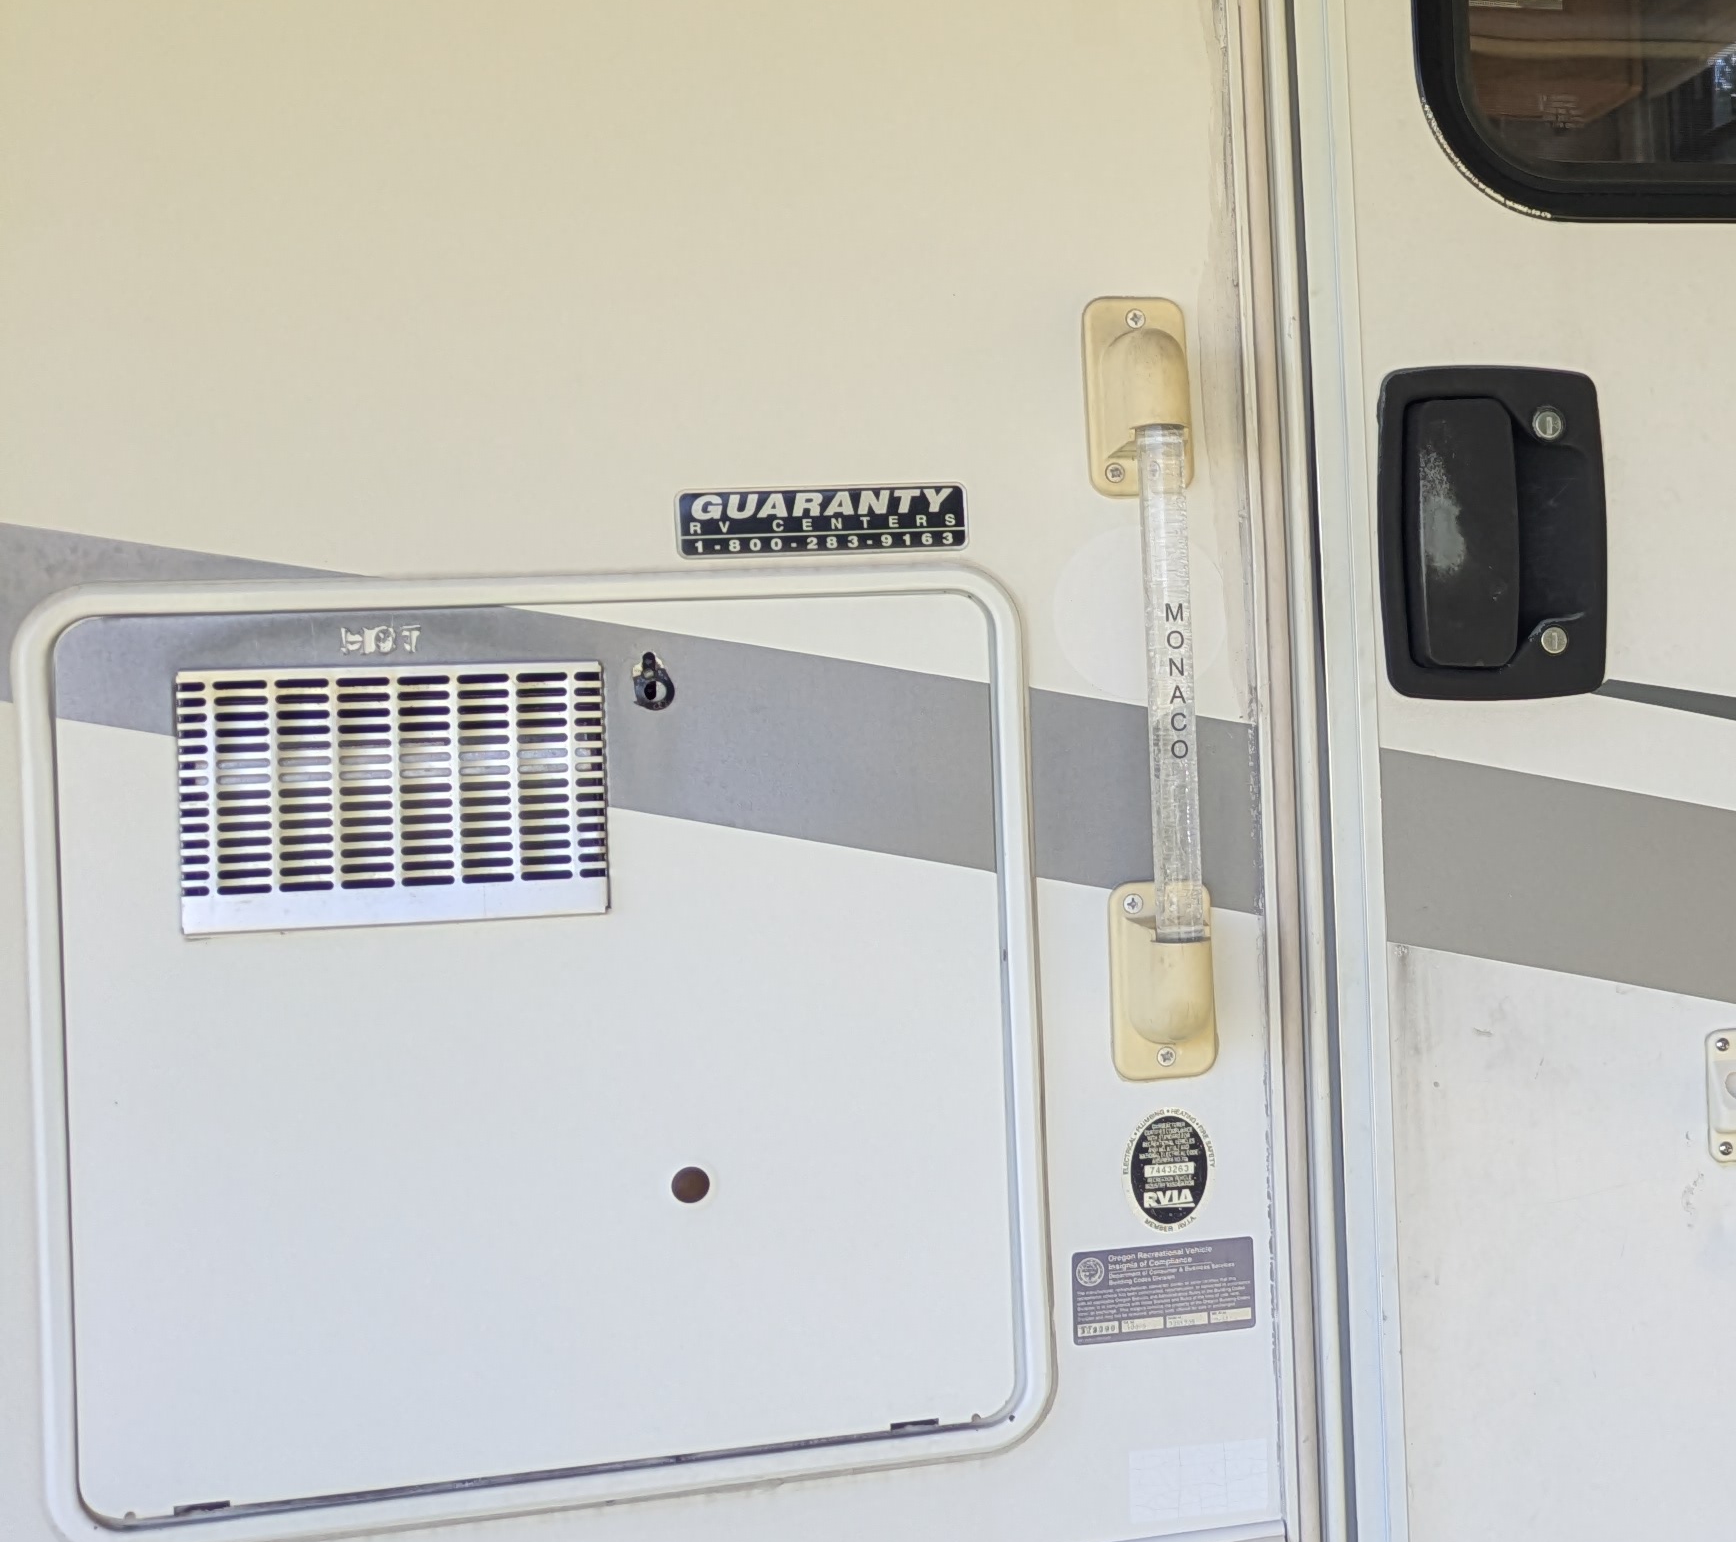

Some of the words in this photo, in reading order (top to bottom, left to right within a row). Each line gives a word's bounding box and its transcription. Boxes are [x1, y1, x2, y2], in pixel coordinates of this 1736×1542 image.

[690, 488, 954, 520] GUARANTY
[772, 514, 957, 532] CENTERS
[694, 532, 955, 554] 1-800-283-9163
[1164, 602, 1189, 759] MONACO
[1136, 1108, 1165, 1133] PLUMBING
[1170, 1108, 1196, 1124] HEATING
[1122, 1137, 1137, 1175] ELECTRICAL
[1205, 1140, 1216, 1168] SAFETY
[1149, 1164, 1190, 1175] 7443263
[1143, 1188, 1194, 1208] RVIA
[1108, 1253, 1136, 1263] Oregon
[1137, 1249, 1184, 1260] Recreational
[1185, 1246, 1213, 1255] Vehicle
[1108, 1261, 1138, 1271] Insignia
[1139, 1260, 1148, 1268] of
[1148, 1256, 1193, 1267] Compliance
